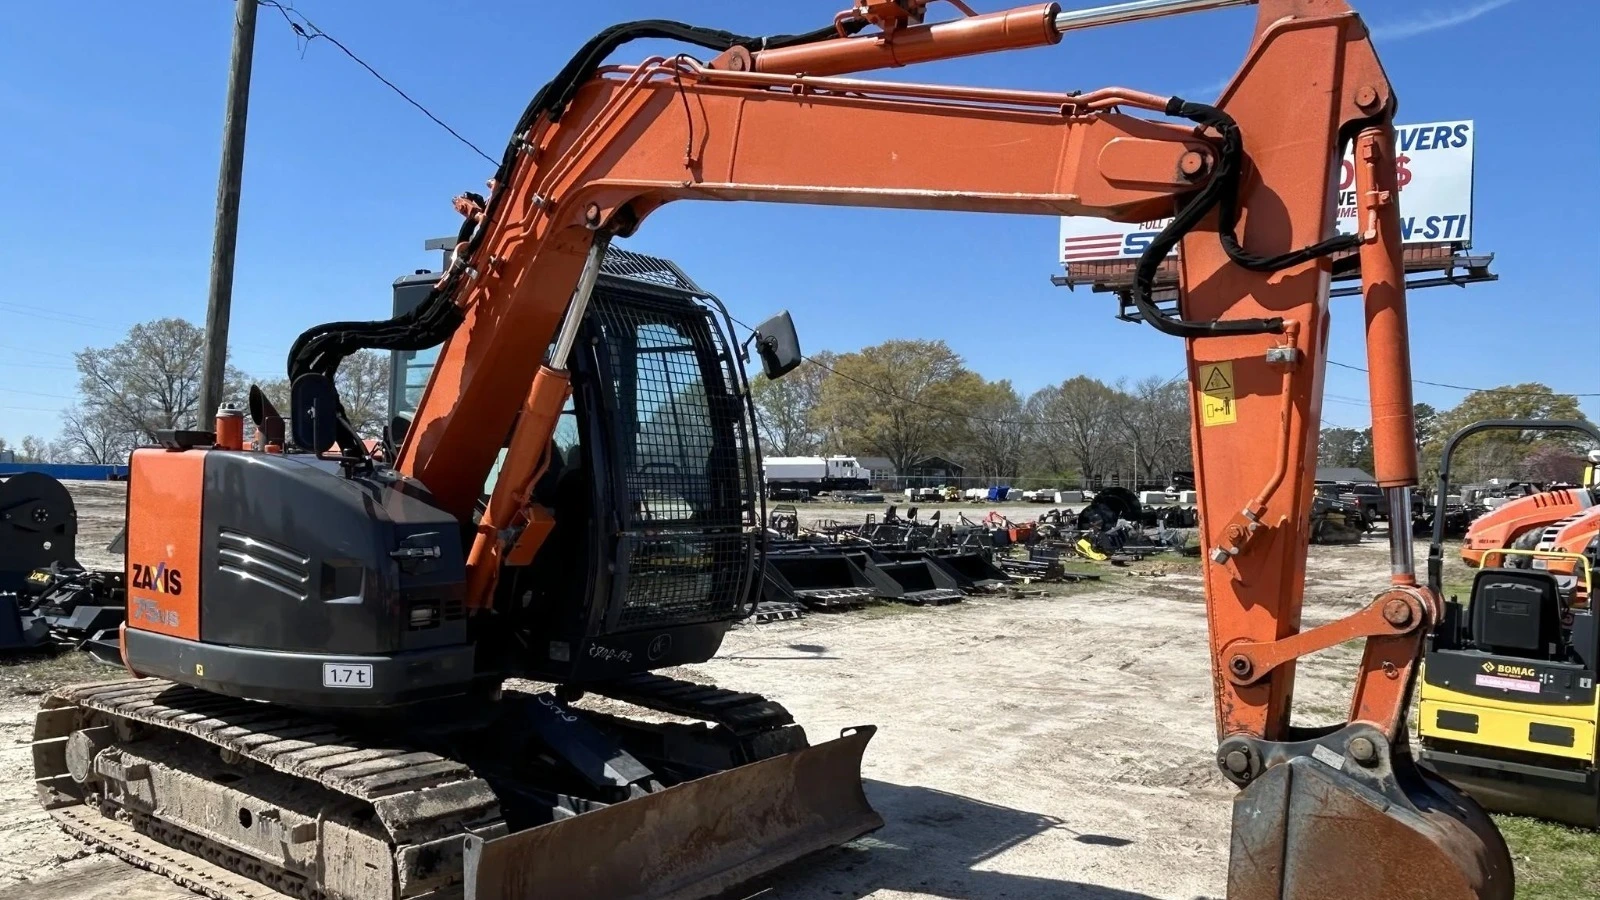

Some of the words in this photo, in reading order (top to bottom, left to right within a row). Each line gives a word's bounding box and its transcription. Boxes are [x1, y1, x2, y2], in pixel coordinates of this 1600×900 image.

[132, 562, 182, 596] ZAXIS
[330, 668, 352, 683] 1.7
[356, 669, 366, 683] t
[1497, 664, 1535, 677] BOMAG
